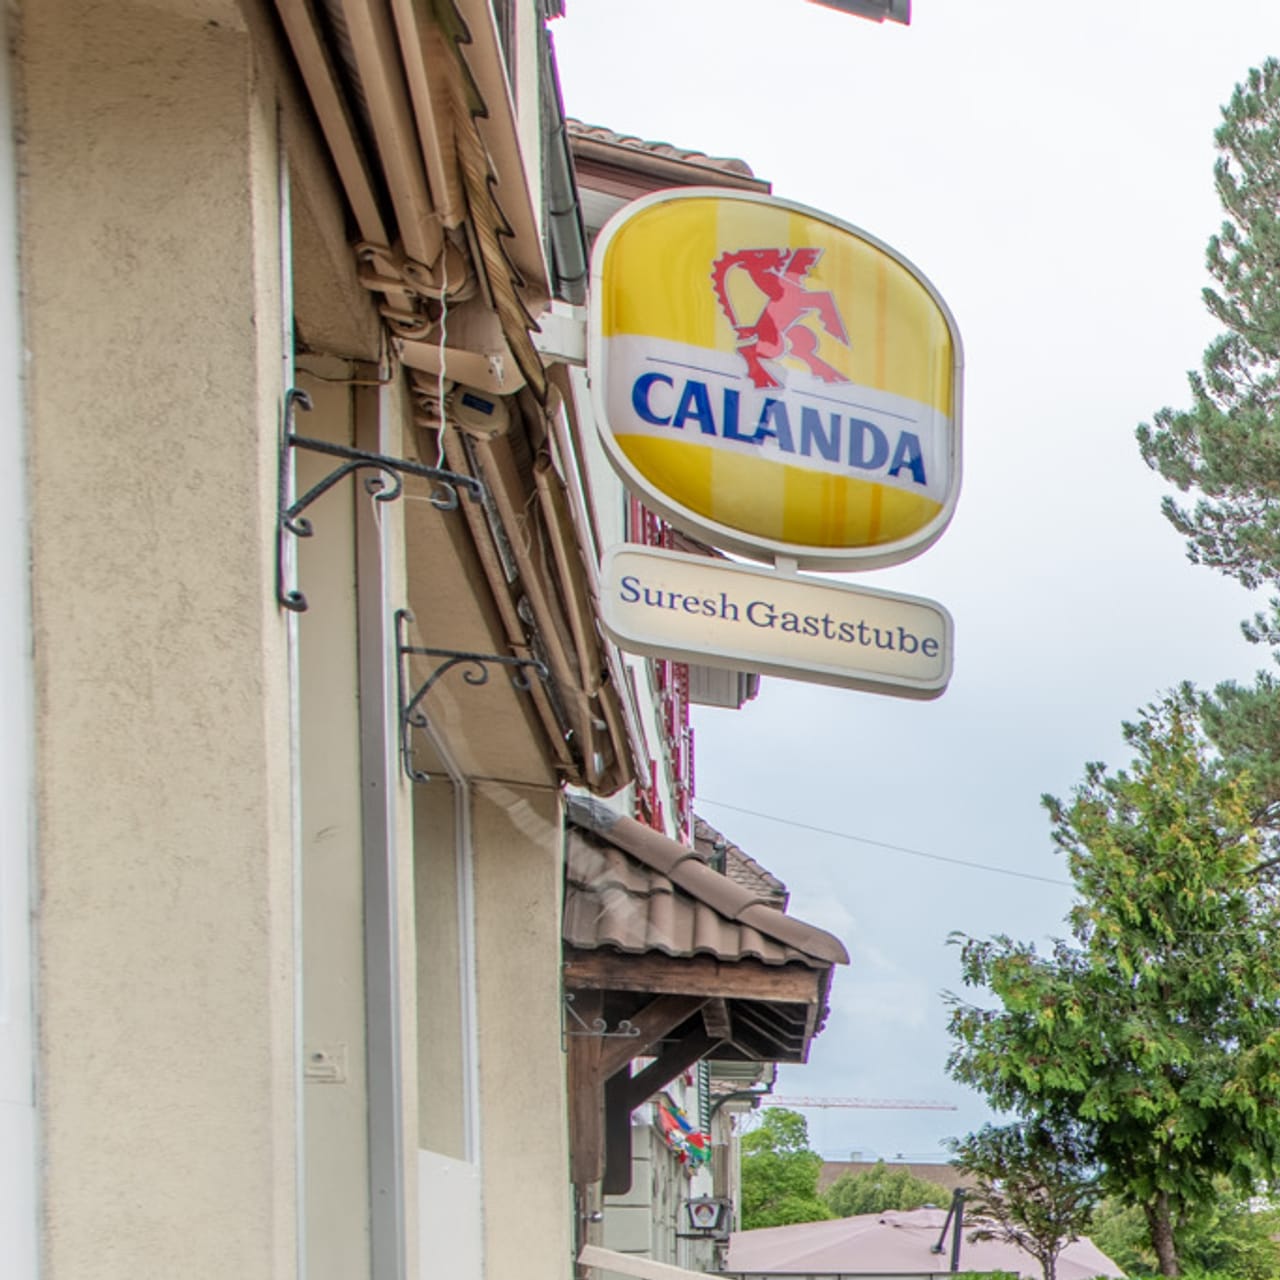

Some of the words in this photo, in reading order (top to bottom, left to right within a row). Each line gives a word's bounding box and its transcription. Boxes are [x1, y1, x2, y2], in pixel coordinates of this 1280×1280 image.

[630, 371, 928, 485] CALANDA
[620, 576, 740, 622] Suresh
[746, 601, 940, 658] Gaststube
